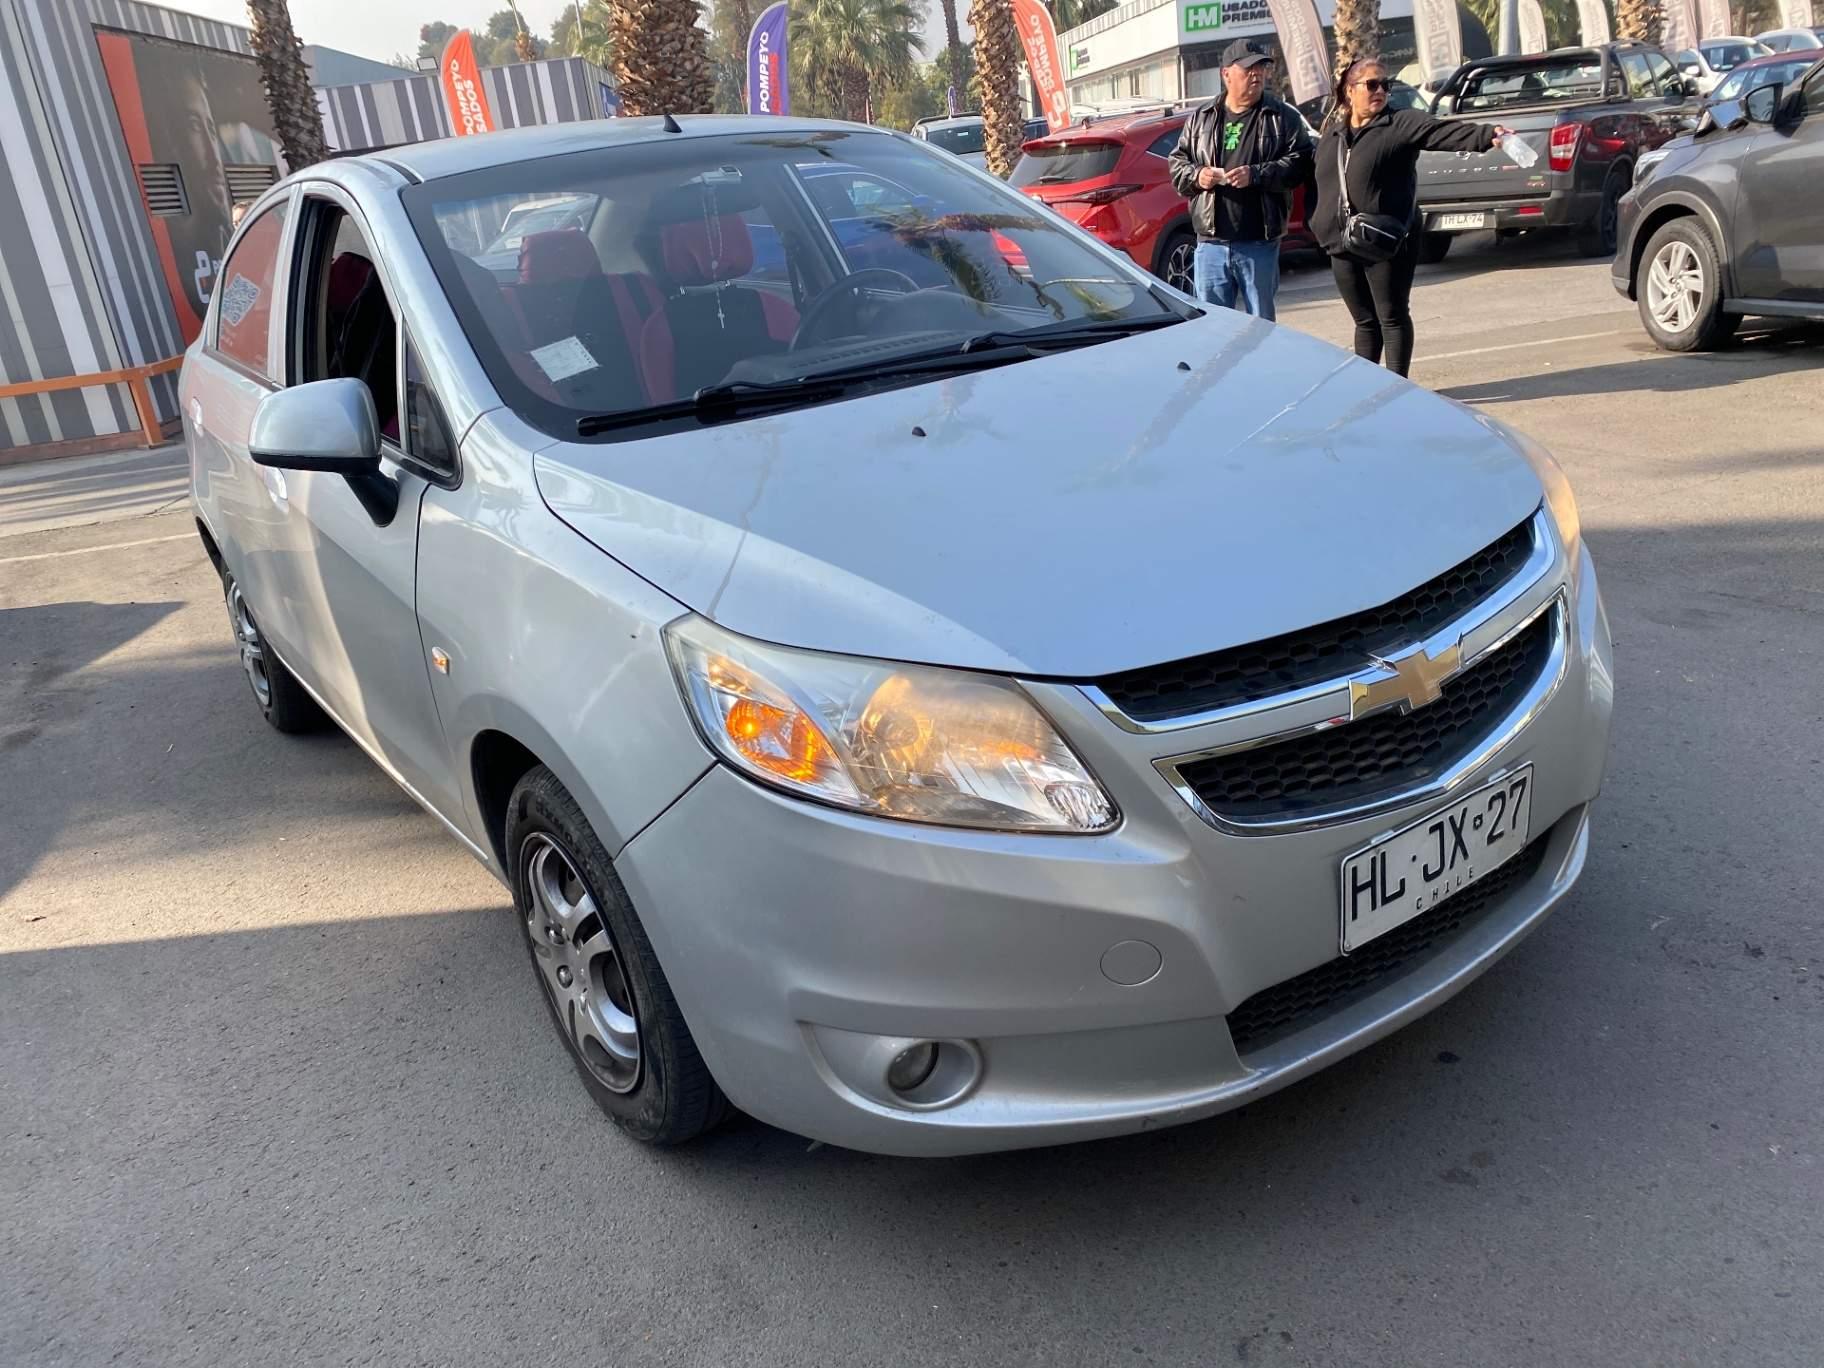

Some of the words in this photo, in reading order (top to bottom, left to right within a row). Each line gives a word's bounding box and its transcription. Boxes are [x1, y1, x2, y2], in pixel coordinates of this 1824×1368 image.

[1187, 5, 1218, 28] HM
[1222, 0, 1268, 12] USADO
[1222, 9, 1273, 24] PREMIU
[759, 31, 770, 113] POMPEYO
[450, 59, 474, 135] POMPEYO
[464, 80, 487, 132] SADOS
[1416, 866, 1474, 910] CHILE
